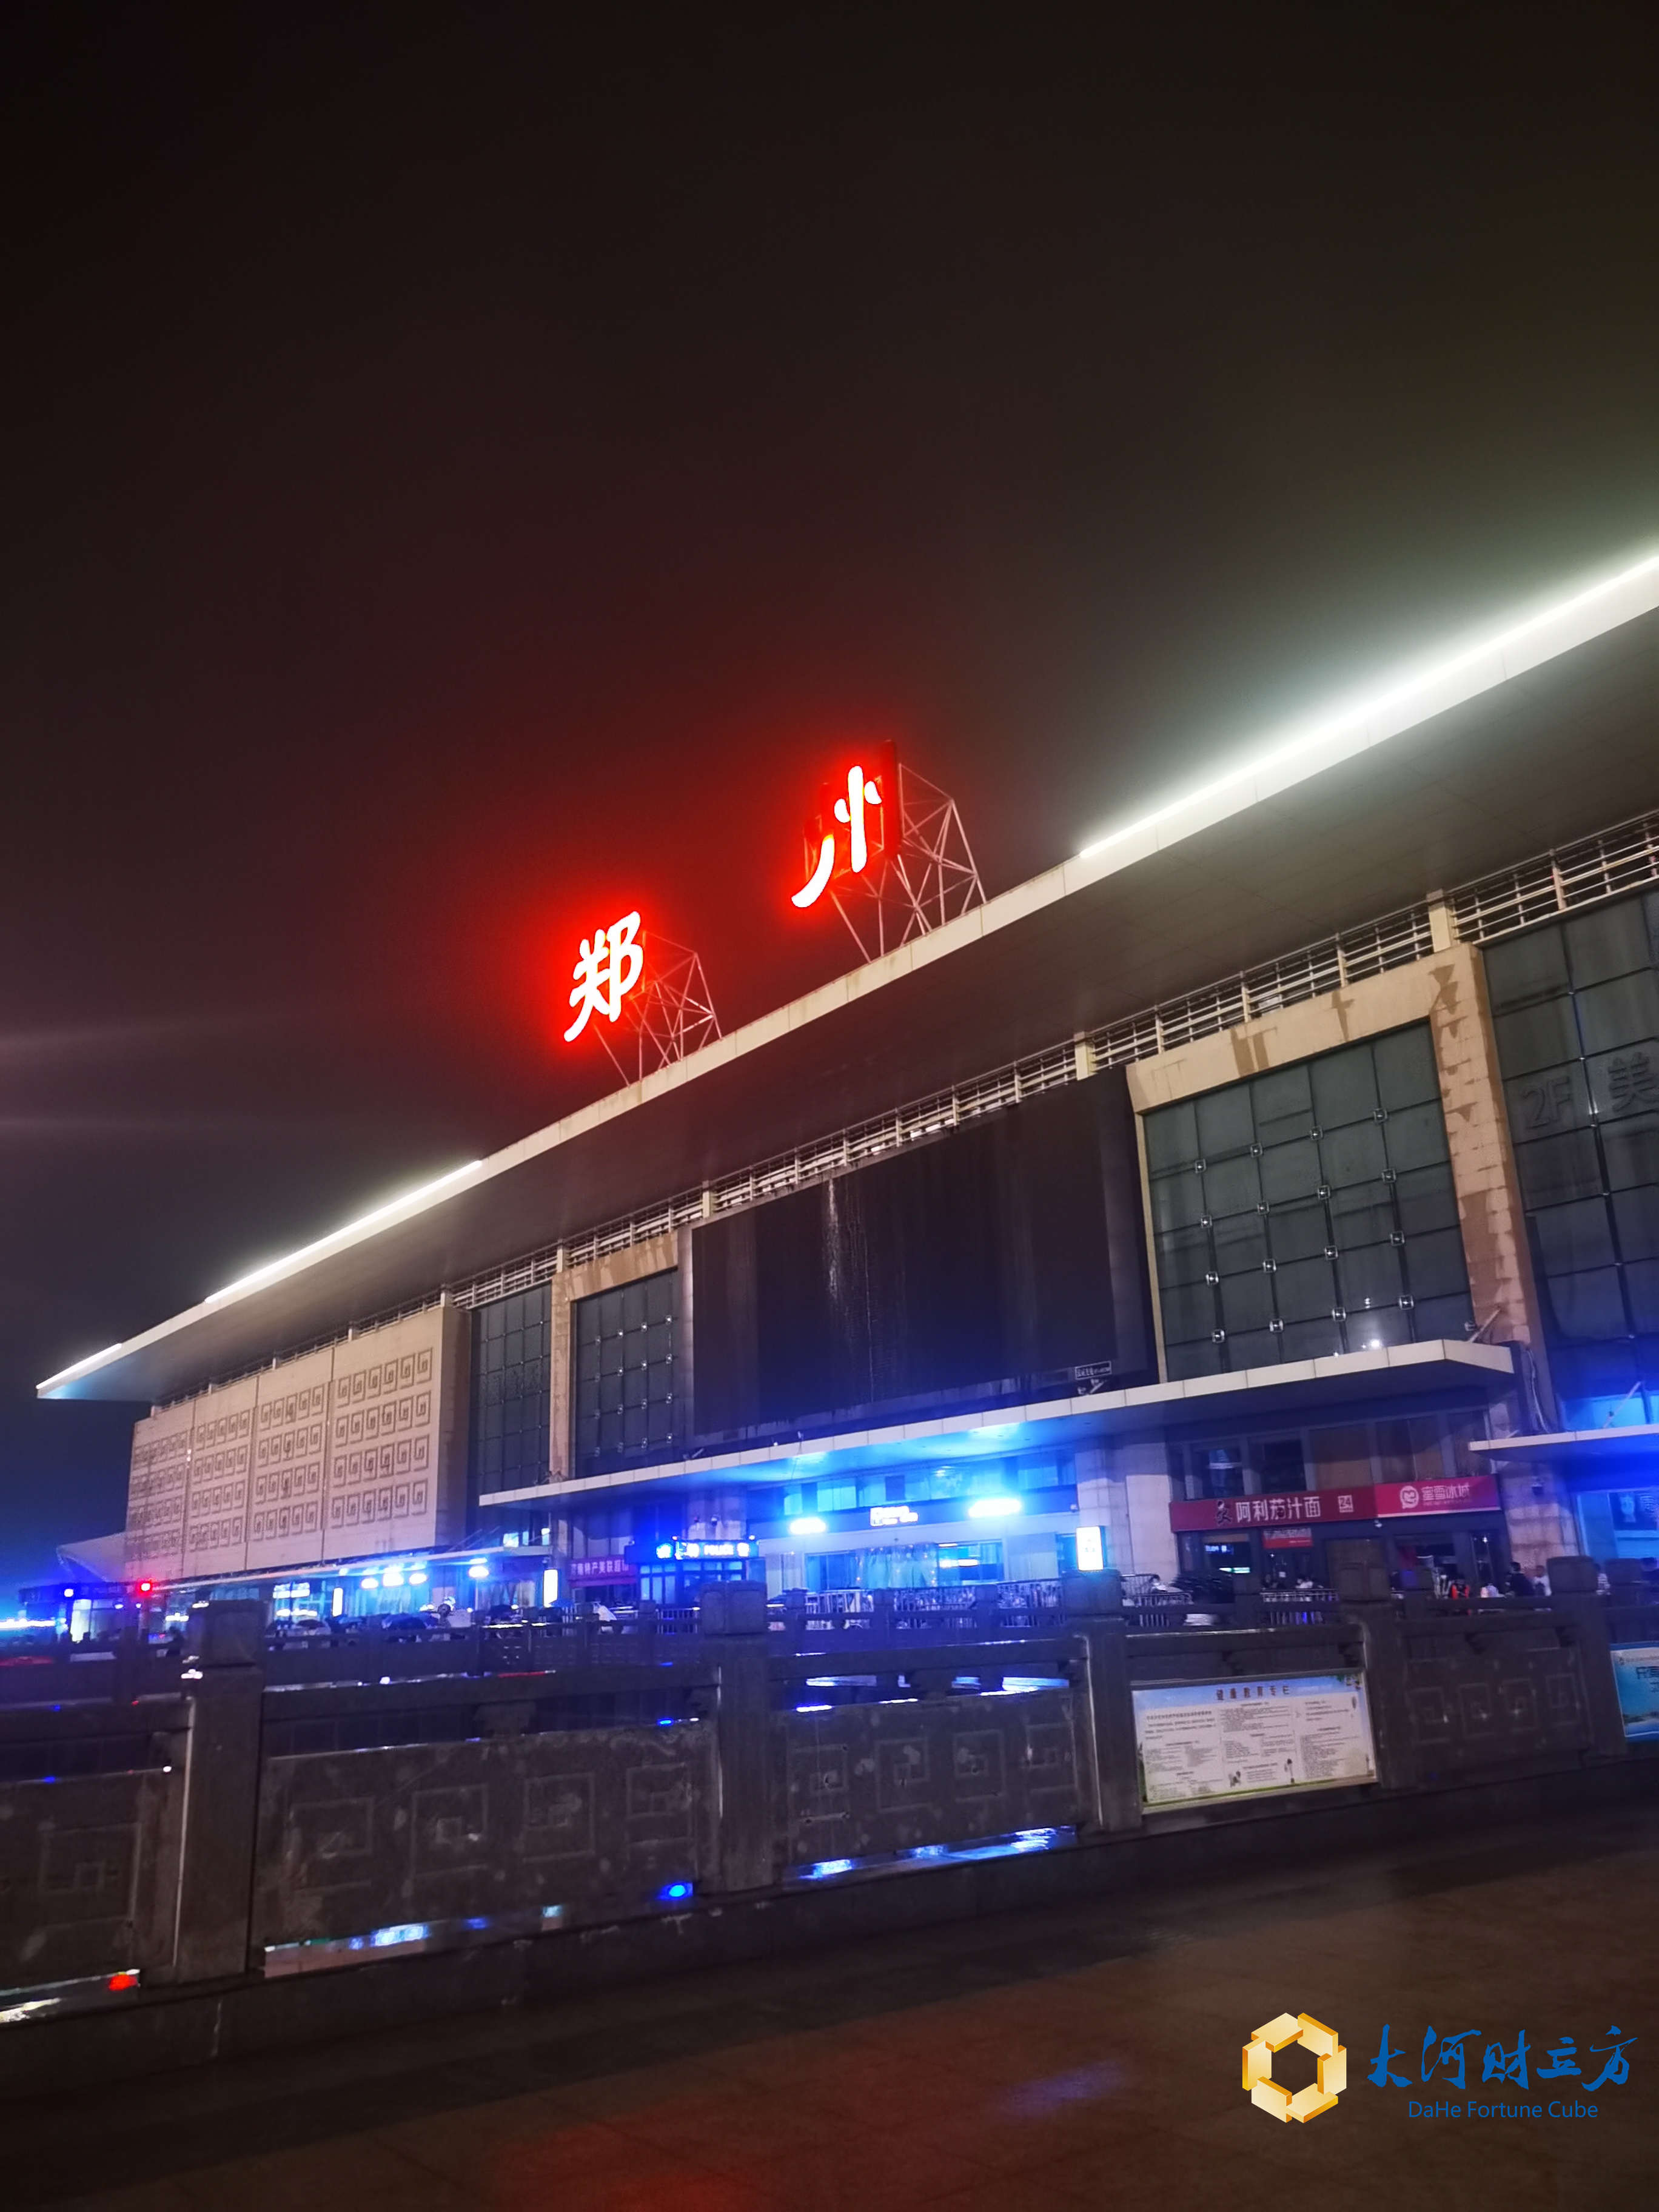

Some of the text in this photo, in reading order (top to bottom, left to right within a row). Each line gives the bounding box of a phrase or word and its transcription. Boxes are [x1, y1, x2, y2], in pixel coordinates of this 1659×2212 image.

[565, 741, 902, 1041] 郑州
[1520, 1076, 1572, 1130] 2F
[1235, 1496, 1321, 1523] 阿利茄汁面
[1421, 1483, 1470, 1501] 蜜雪冰城
